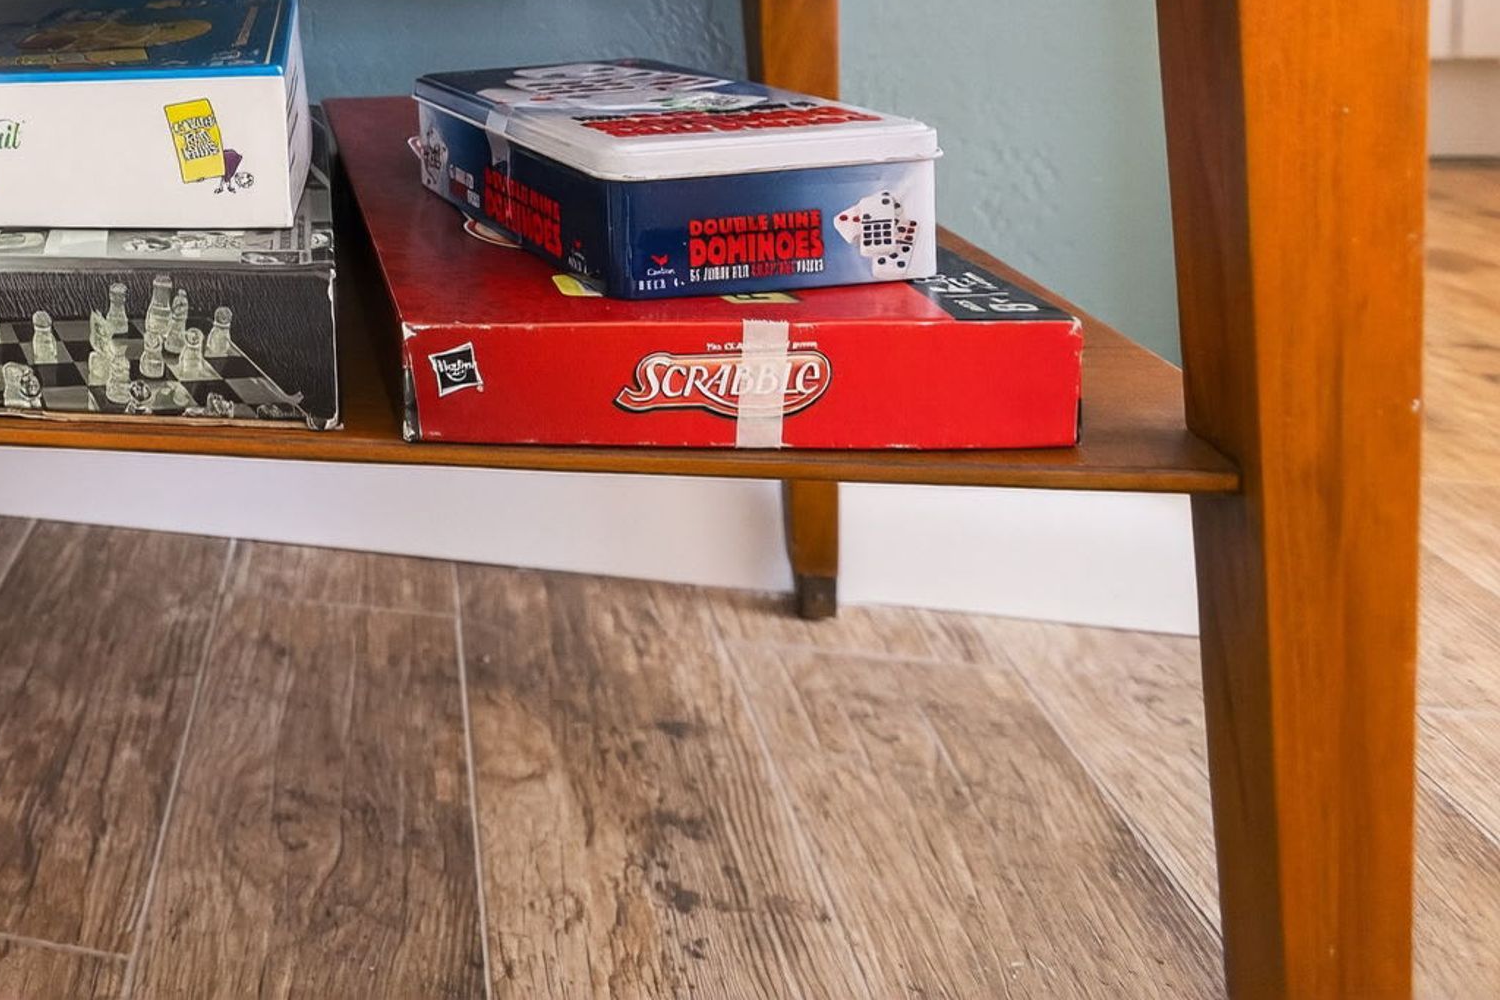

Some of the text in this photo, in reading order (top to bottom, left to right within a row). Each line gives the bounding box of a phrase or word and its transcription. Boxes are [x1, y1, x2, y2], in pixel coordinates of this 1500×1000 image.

[689, 209, 822, 236] DOUBLE NINE
[689, 230, 825, 268] DOMINOES
[625, 357, 821, 405] SCRABBLE
